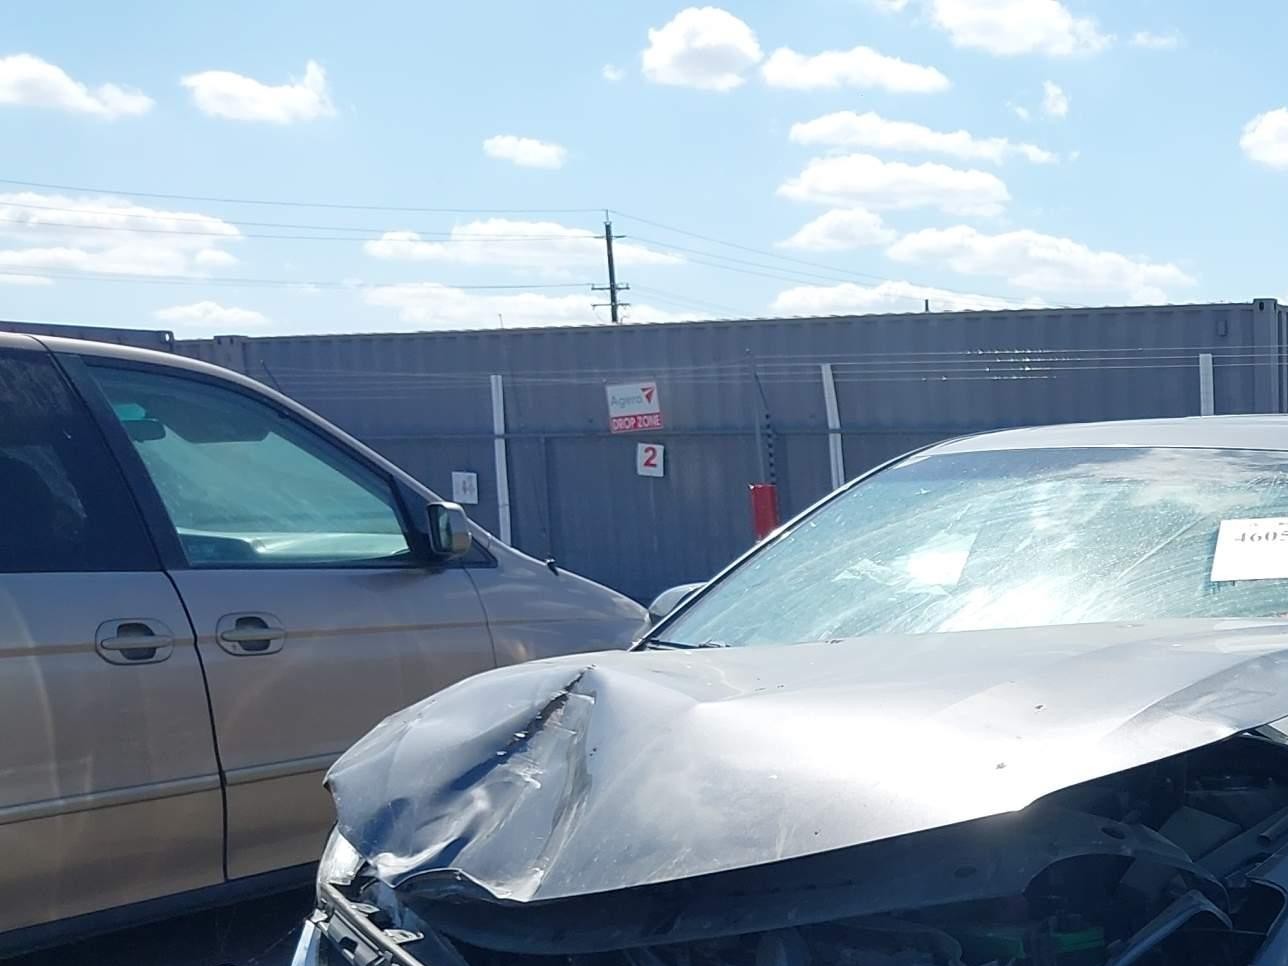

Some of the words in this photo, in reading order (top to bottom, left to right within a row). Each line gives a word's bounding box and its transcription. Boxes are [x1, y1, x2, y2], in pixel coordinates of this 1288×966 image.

[612, 417, 636, 430] DROP
[637, 415, 661, 428] ZONE
[643, 446, 657, 468] 2
